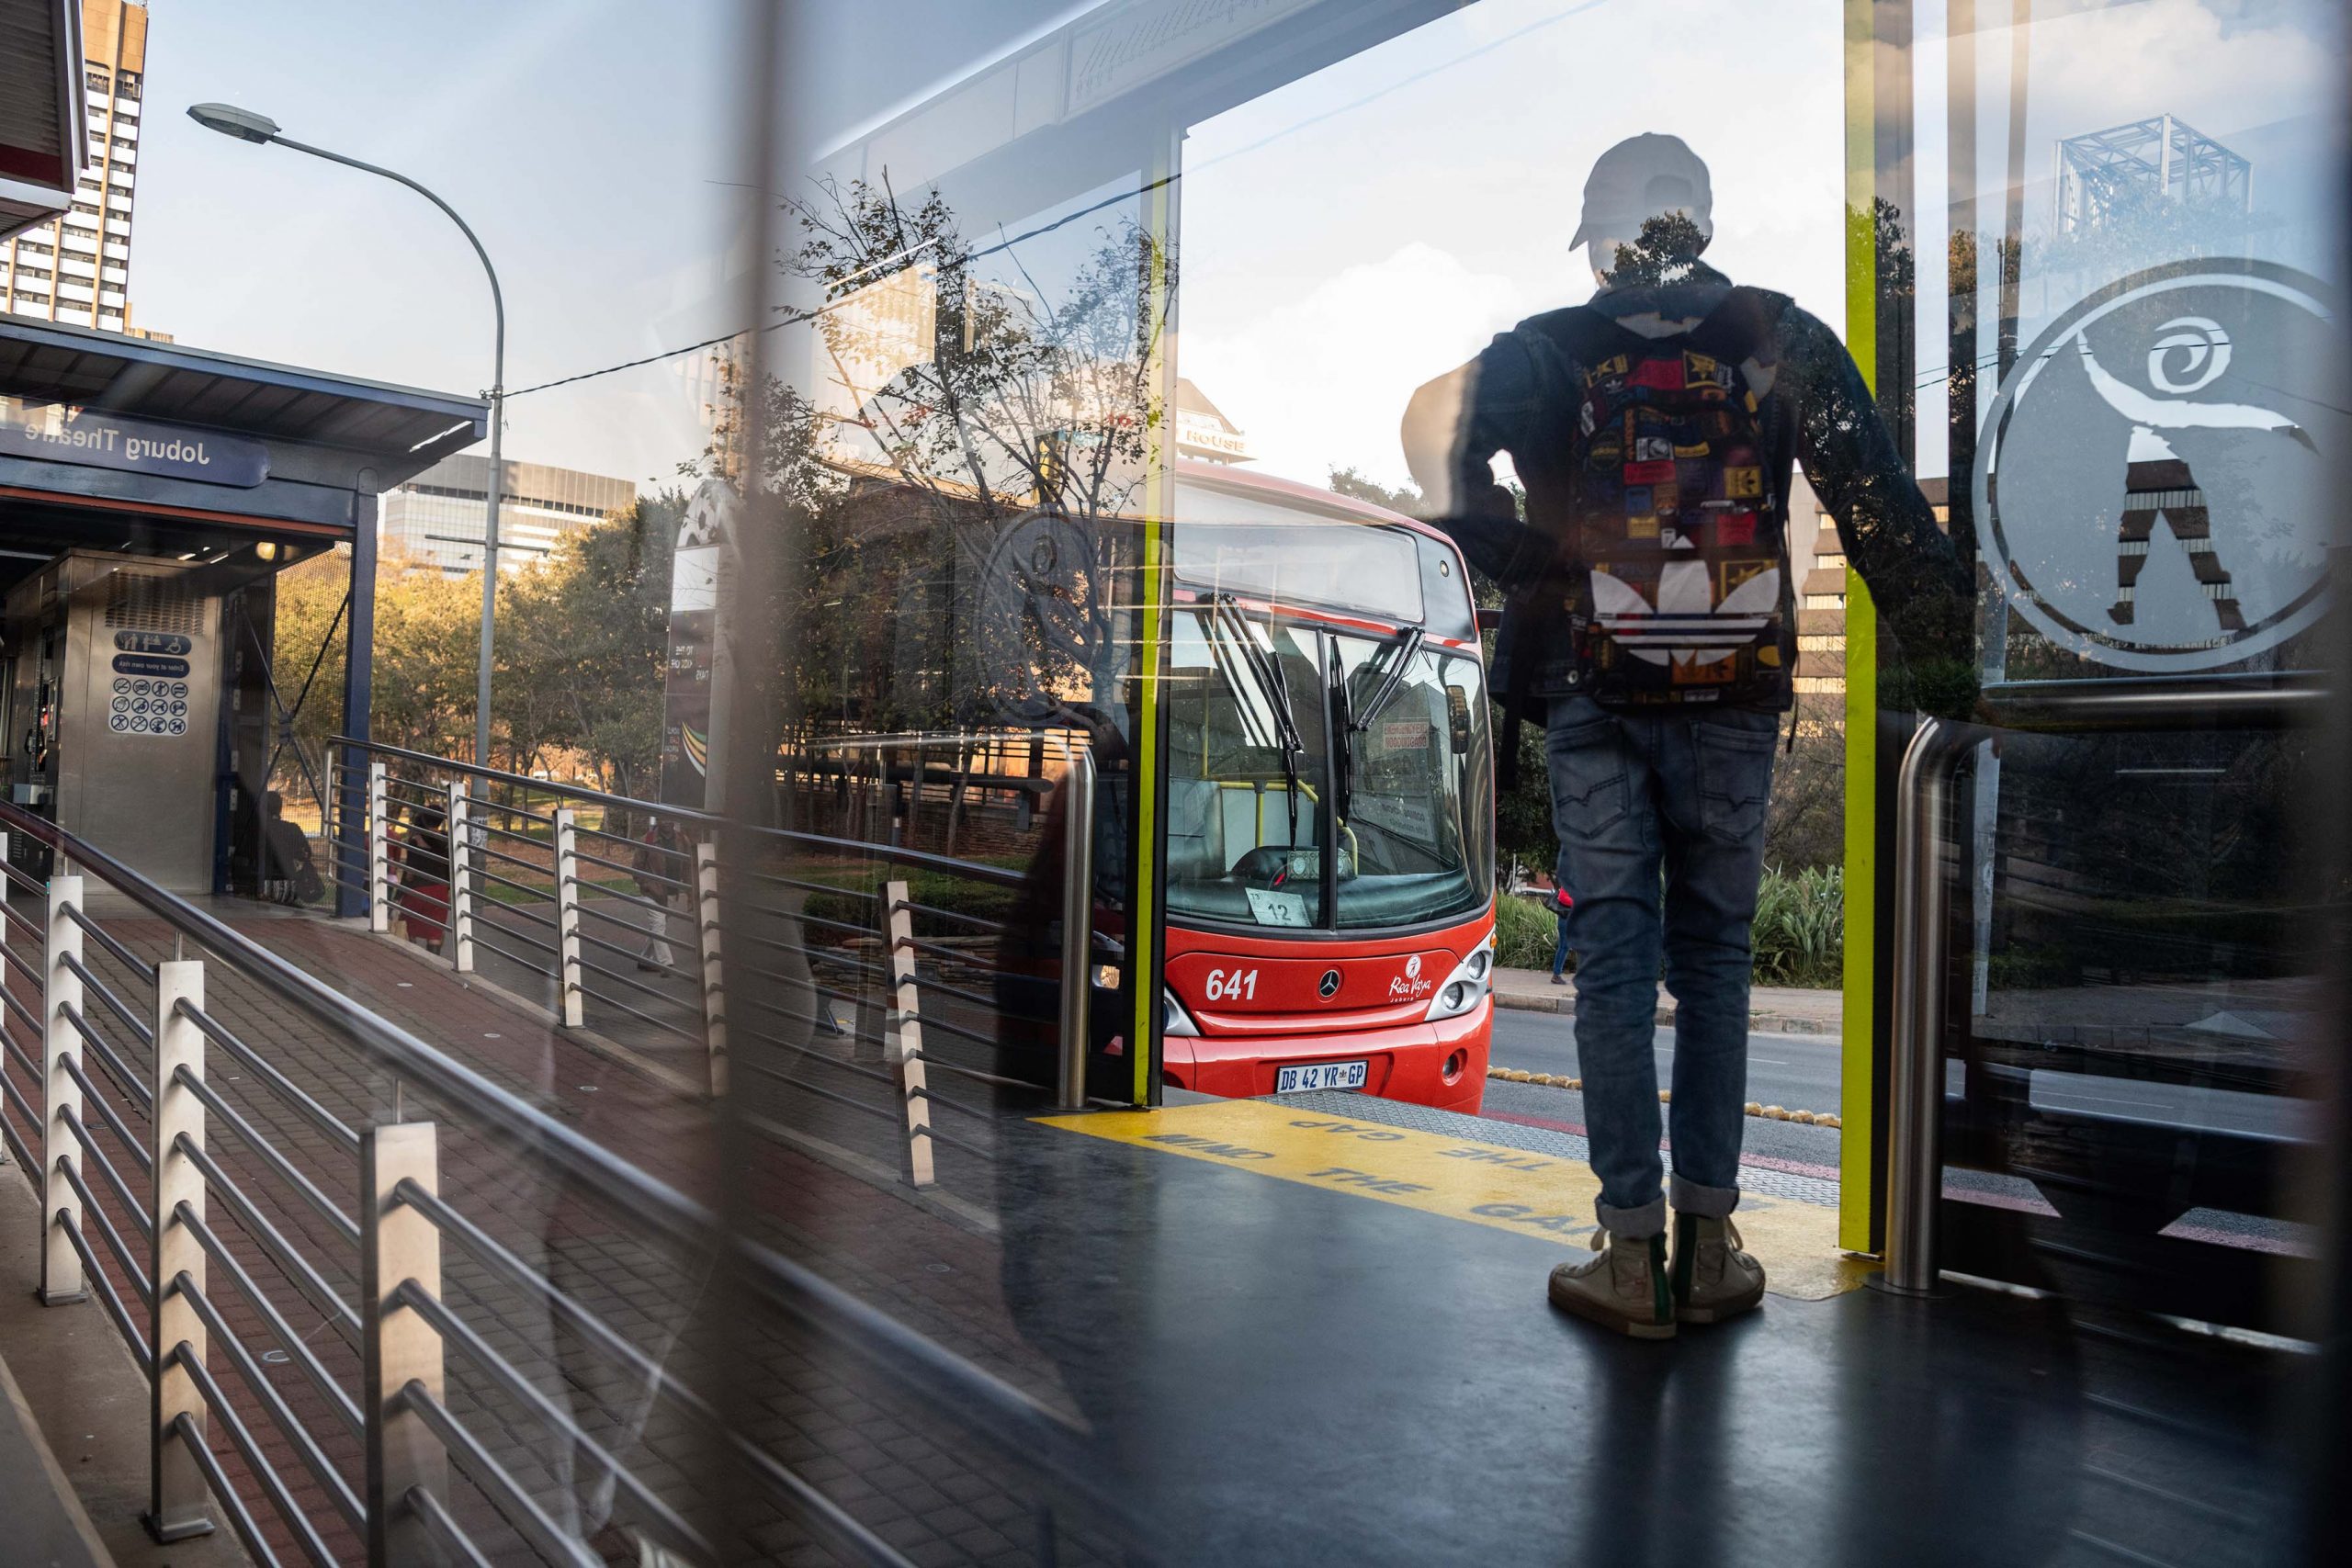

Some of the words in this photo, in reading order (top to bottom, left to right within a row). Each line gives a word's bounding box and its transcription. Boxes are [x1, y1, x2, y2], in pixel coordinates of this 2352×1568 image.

[1186, 429, 1245, 452] HOUSE
[1268, 903, 1292, 921] 12
[1205, 969, 1258, 1001] 641
[1388, 975, 1409, 997] Rea
[1410, 974, 1431, 998] Vaya
[1281, 1070, 1297, 1091] DB
[1302, 1068, 1318, 1089] 42
[1324, 1066, 1339, 1087] YR
[1348, 1065, 1363, 1085] GP
[1289, 1120, 1406, 1141] GAP
[1142, 1134, 1276, 1159] MIND
[1306, 1167, 1433, 1195] THE
[1435, 1146, 1554, 1172] THE
